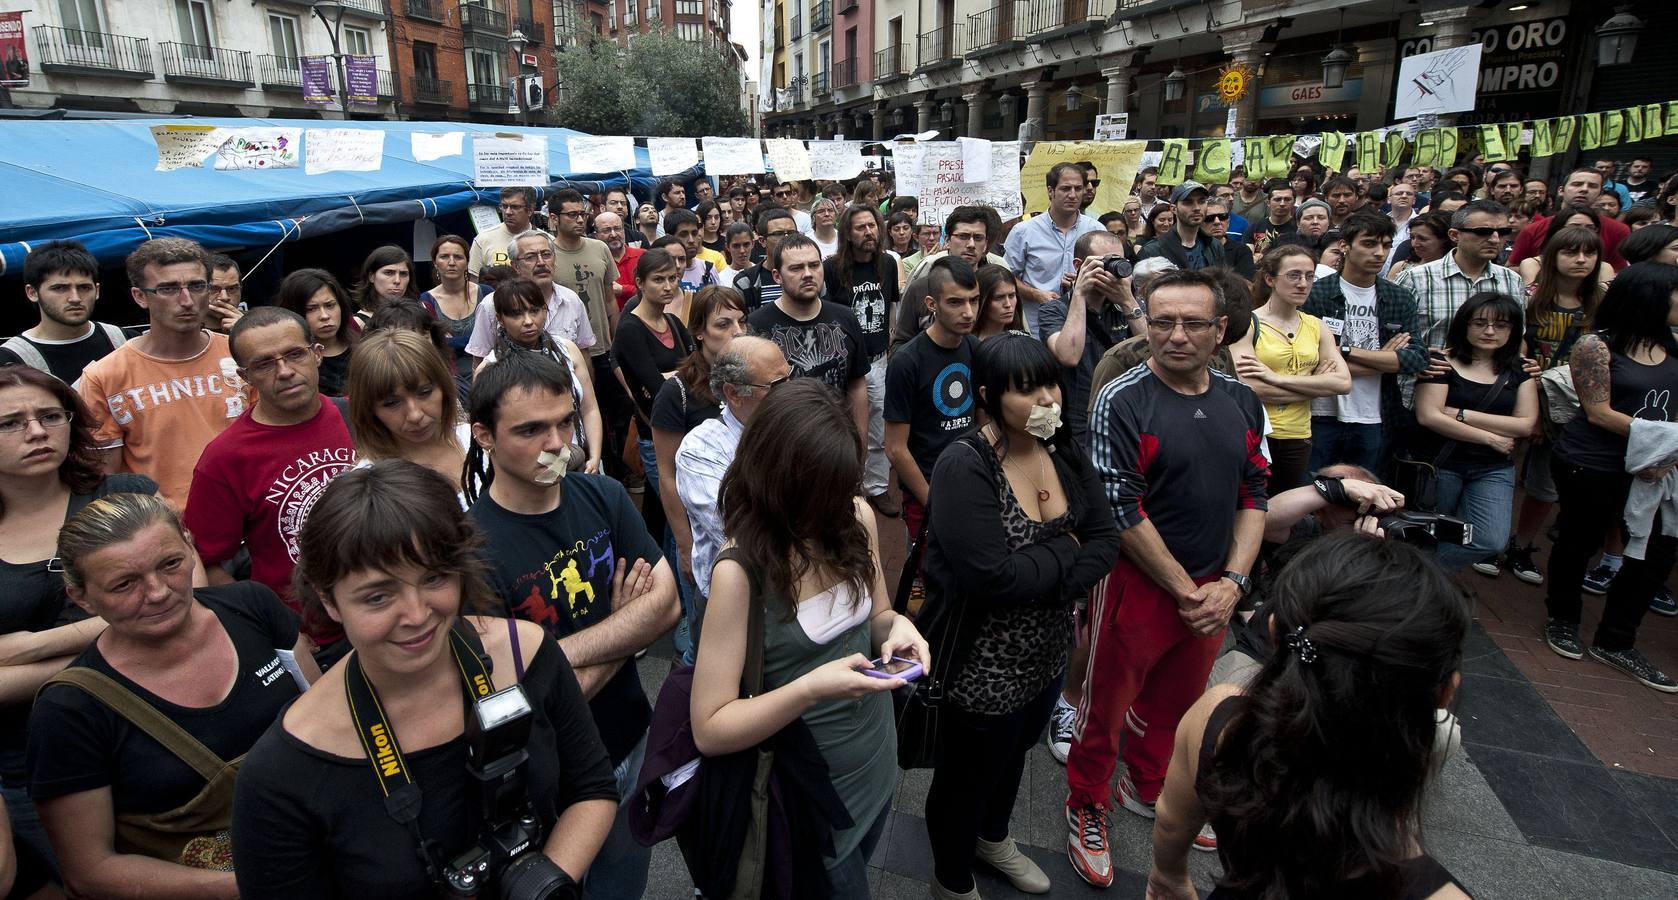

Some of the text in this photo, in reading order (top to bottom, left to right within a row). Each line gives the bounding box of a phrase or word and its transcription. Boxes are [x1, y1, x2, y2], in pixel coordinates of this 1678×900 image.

[1506, 19, 1566, 50] ORO
[1478, 61, 1559, 92] MPRO
[1292, 86, 1322, 100] GAES
[933, 186, 960, 196] PASADO
[106, 373, 223, 425] ETHNIC
[262, 665, 286, 687] LATINO
[370, 723, 401, 778] Nikon
[510, 841, 530, 857] Nikon
